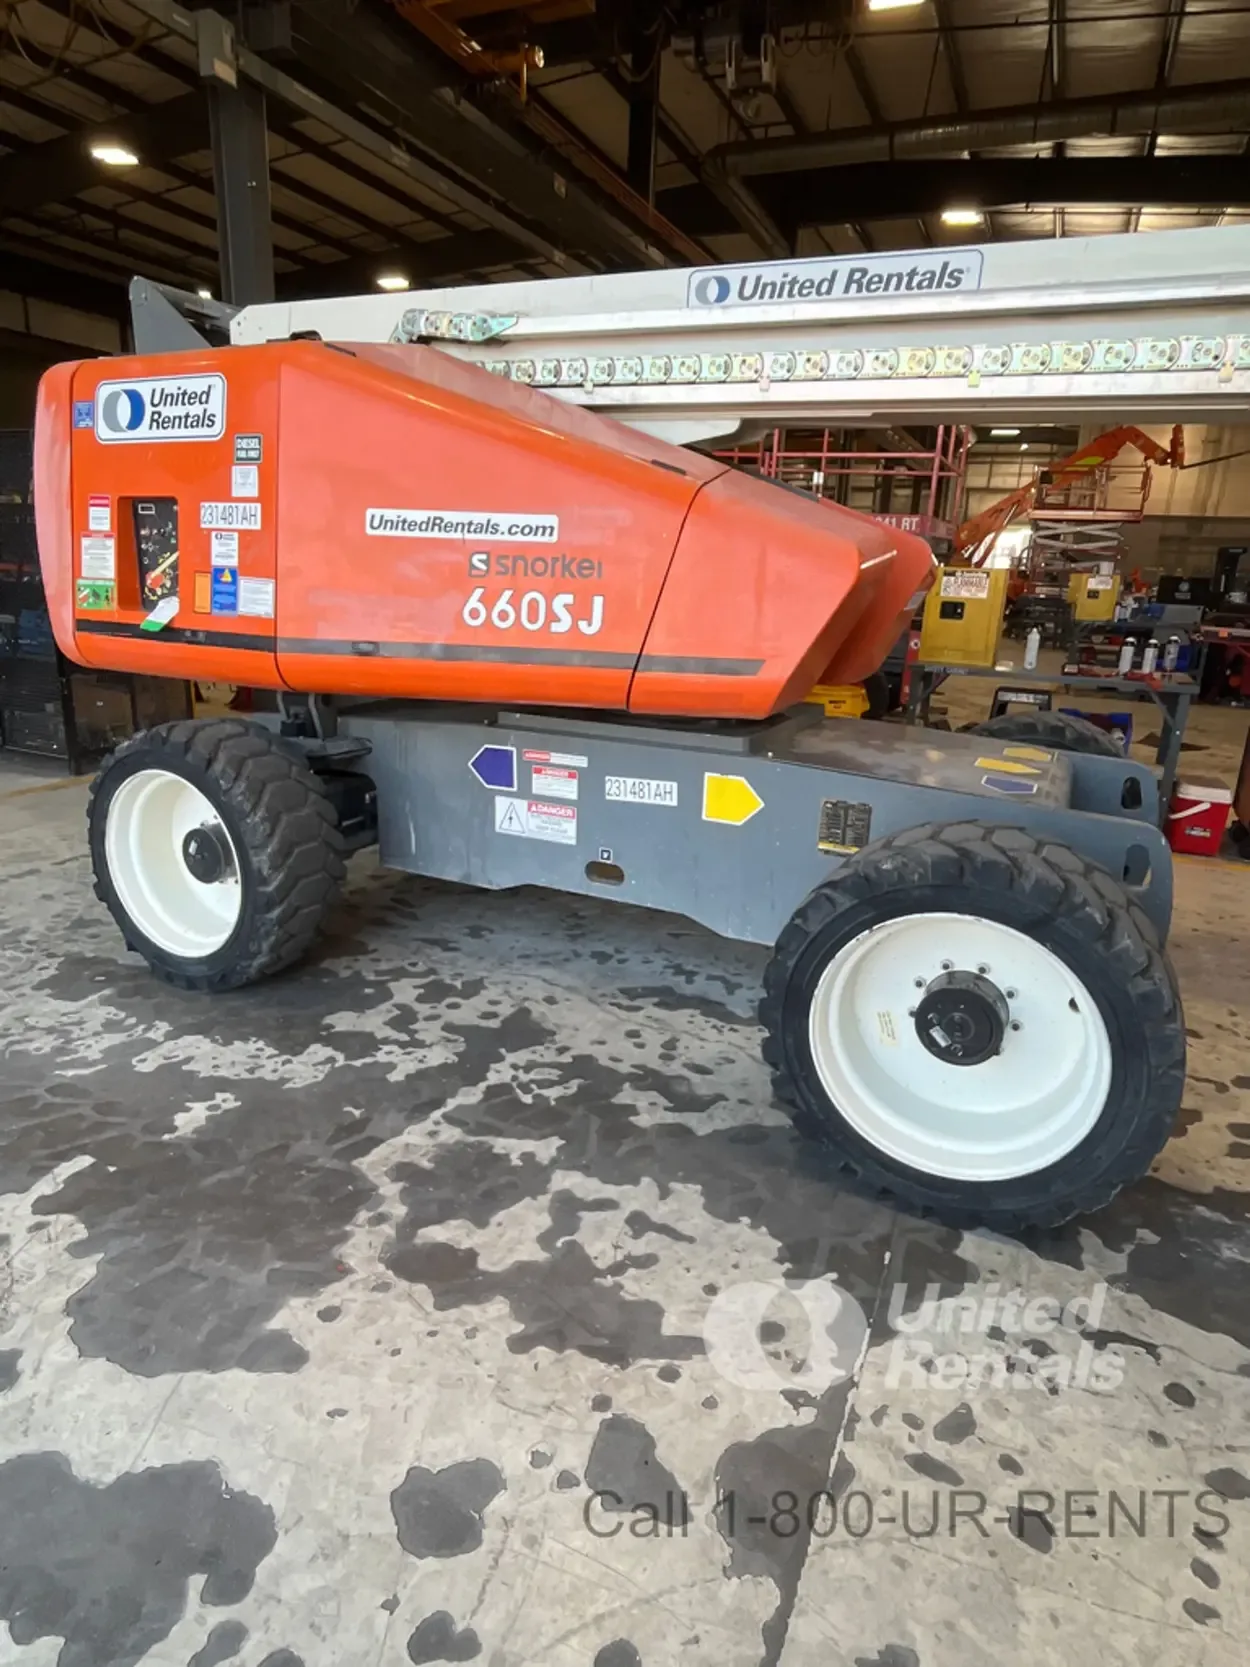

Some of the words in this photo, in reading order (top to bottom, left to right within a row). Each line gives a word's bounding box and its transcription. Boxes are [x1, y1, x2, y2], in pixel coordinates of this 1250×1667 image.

[737, 269, 838, 301] United
[842, 261, 964, 294] Rentals
[151, 384, 212, 408] United
[149, 408, 216, 431] Rentals
[201, 503, 259, 526] 231481AH
[369, 513, 555, 538] UnitedRentals.com
[901, 517, 920, 531] RT
[462, 586, 605, 635] 660SJ
[605, 778, 674, 803] 231481AH
[535, 804, 574, 817] DANGER
